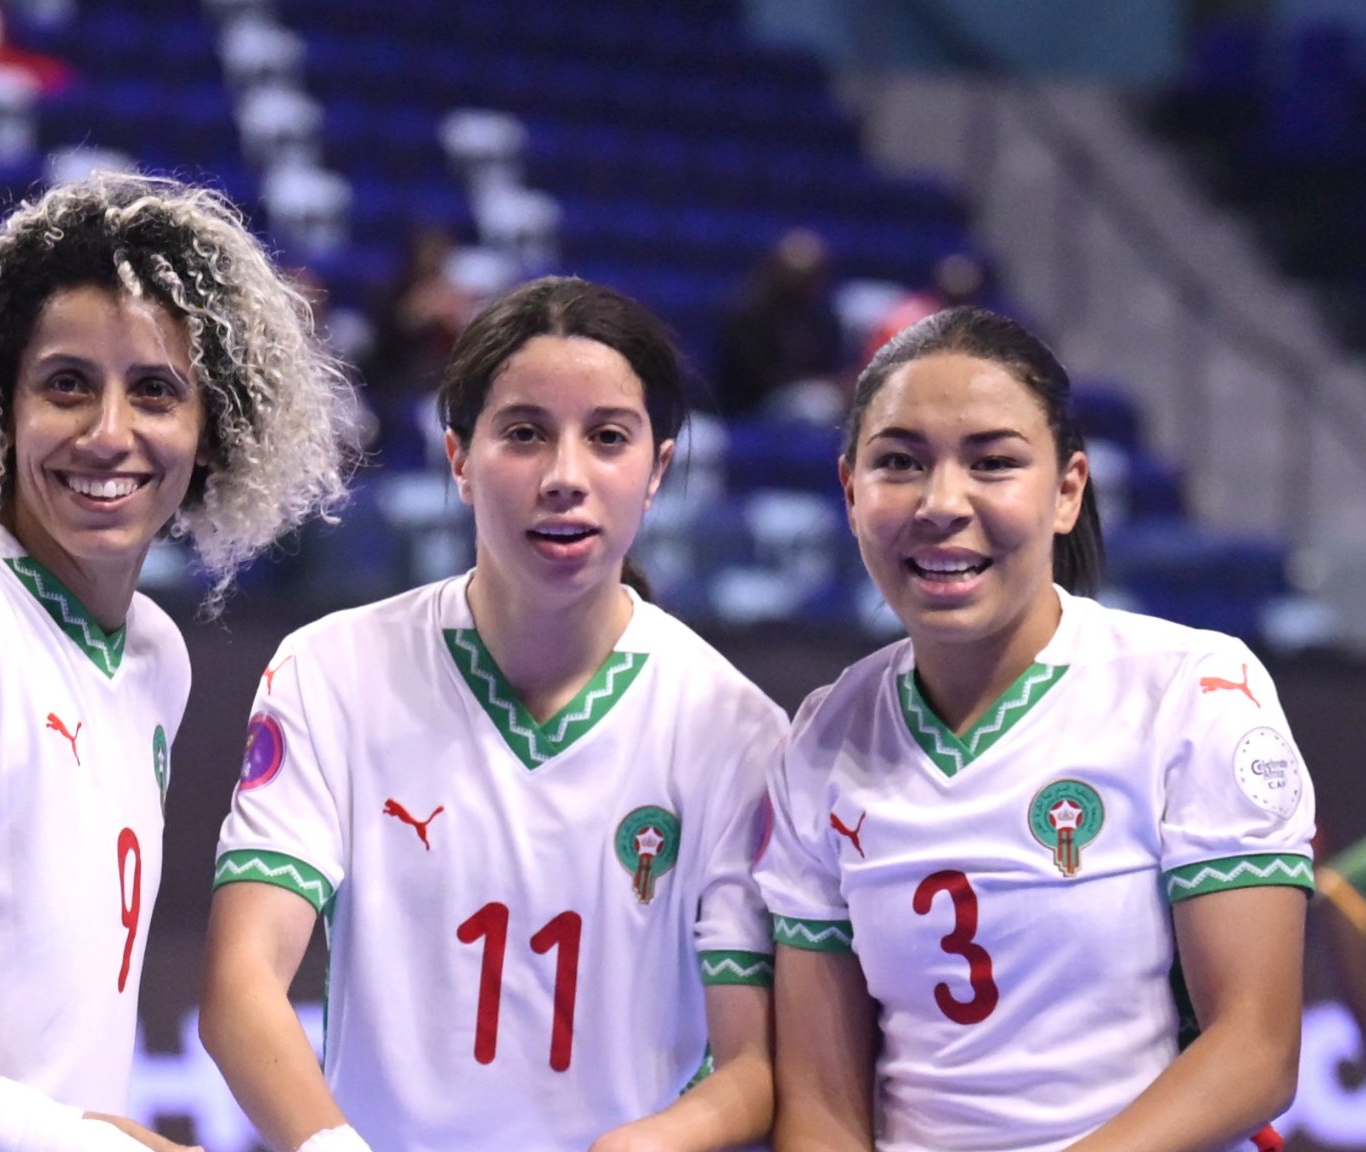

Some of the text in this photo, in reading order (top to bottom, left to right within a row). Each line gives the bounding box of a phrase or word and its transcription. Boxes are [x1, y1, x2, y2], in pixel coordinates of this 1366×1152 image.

[116, 826, 142, 994] 9
[457, 901, 583, 1072] 11
[912, 870, 999, 1025] 3
